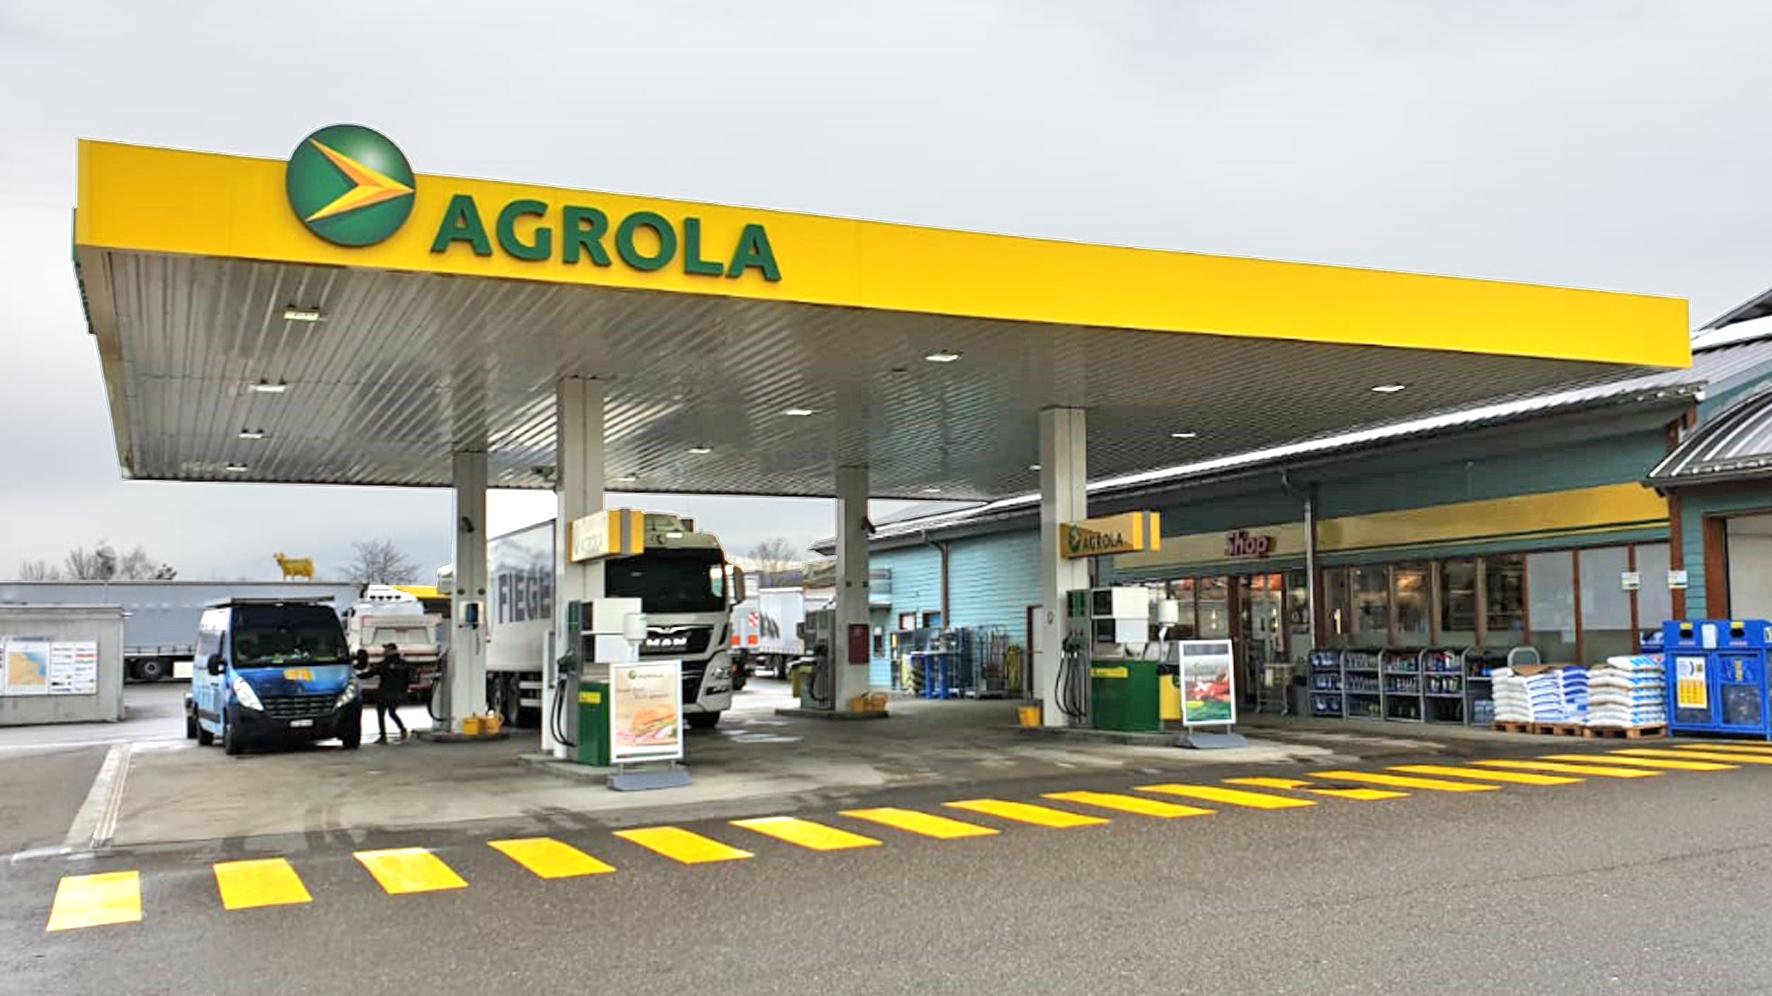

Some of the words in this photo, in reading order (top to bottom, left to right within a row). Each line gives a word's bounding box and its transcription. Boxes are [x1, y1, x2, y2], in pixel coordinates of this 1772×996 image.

[430, 194, 782, 281] AGROLA
[1083, 531, 1124, 552] AGROLA
[498, 570, 551, 624] FIEGE
[646, 637, 687, 646] MAN
